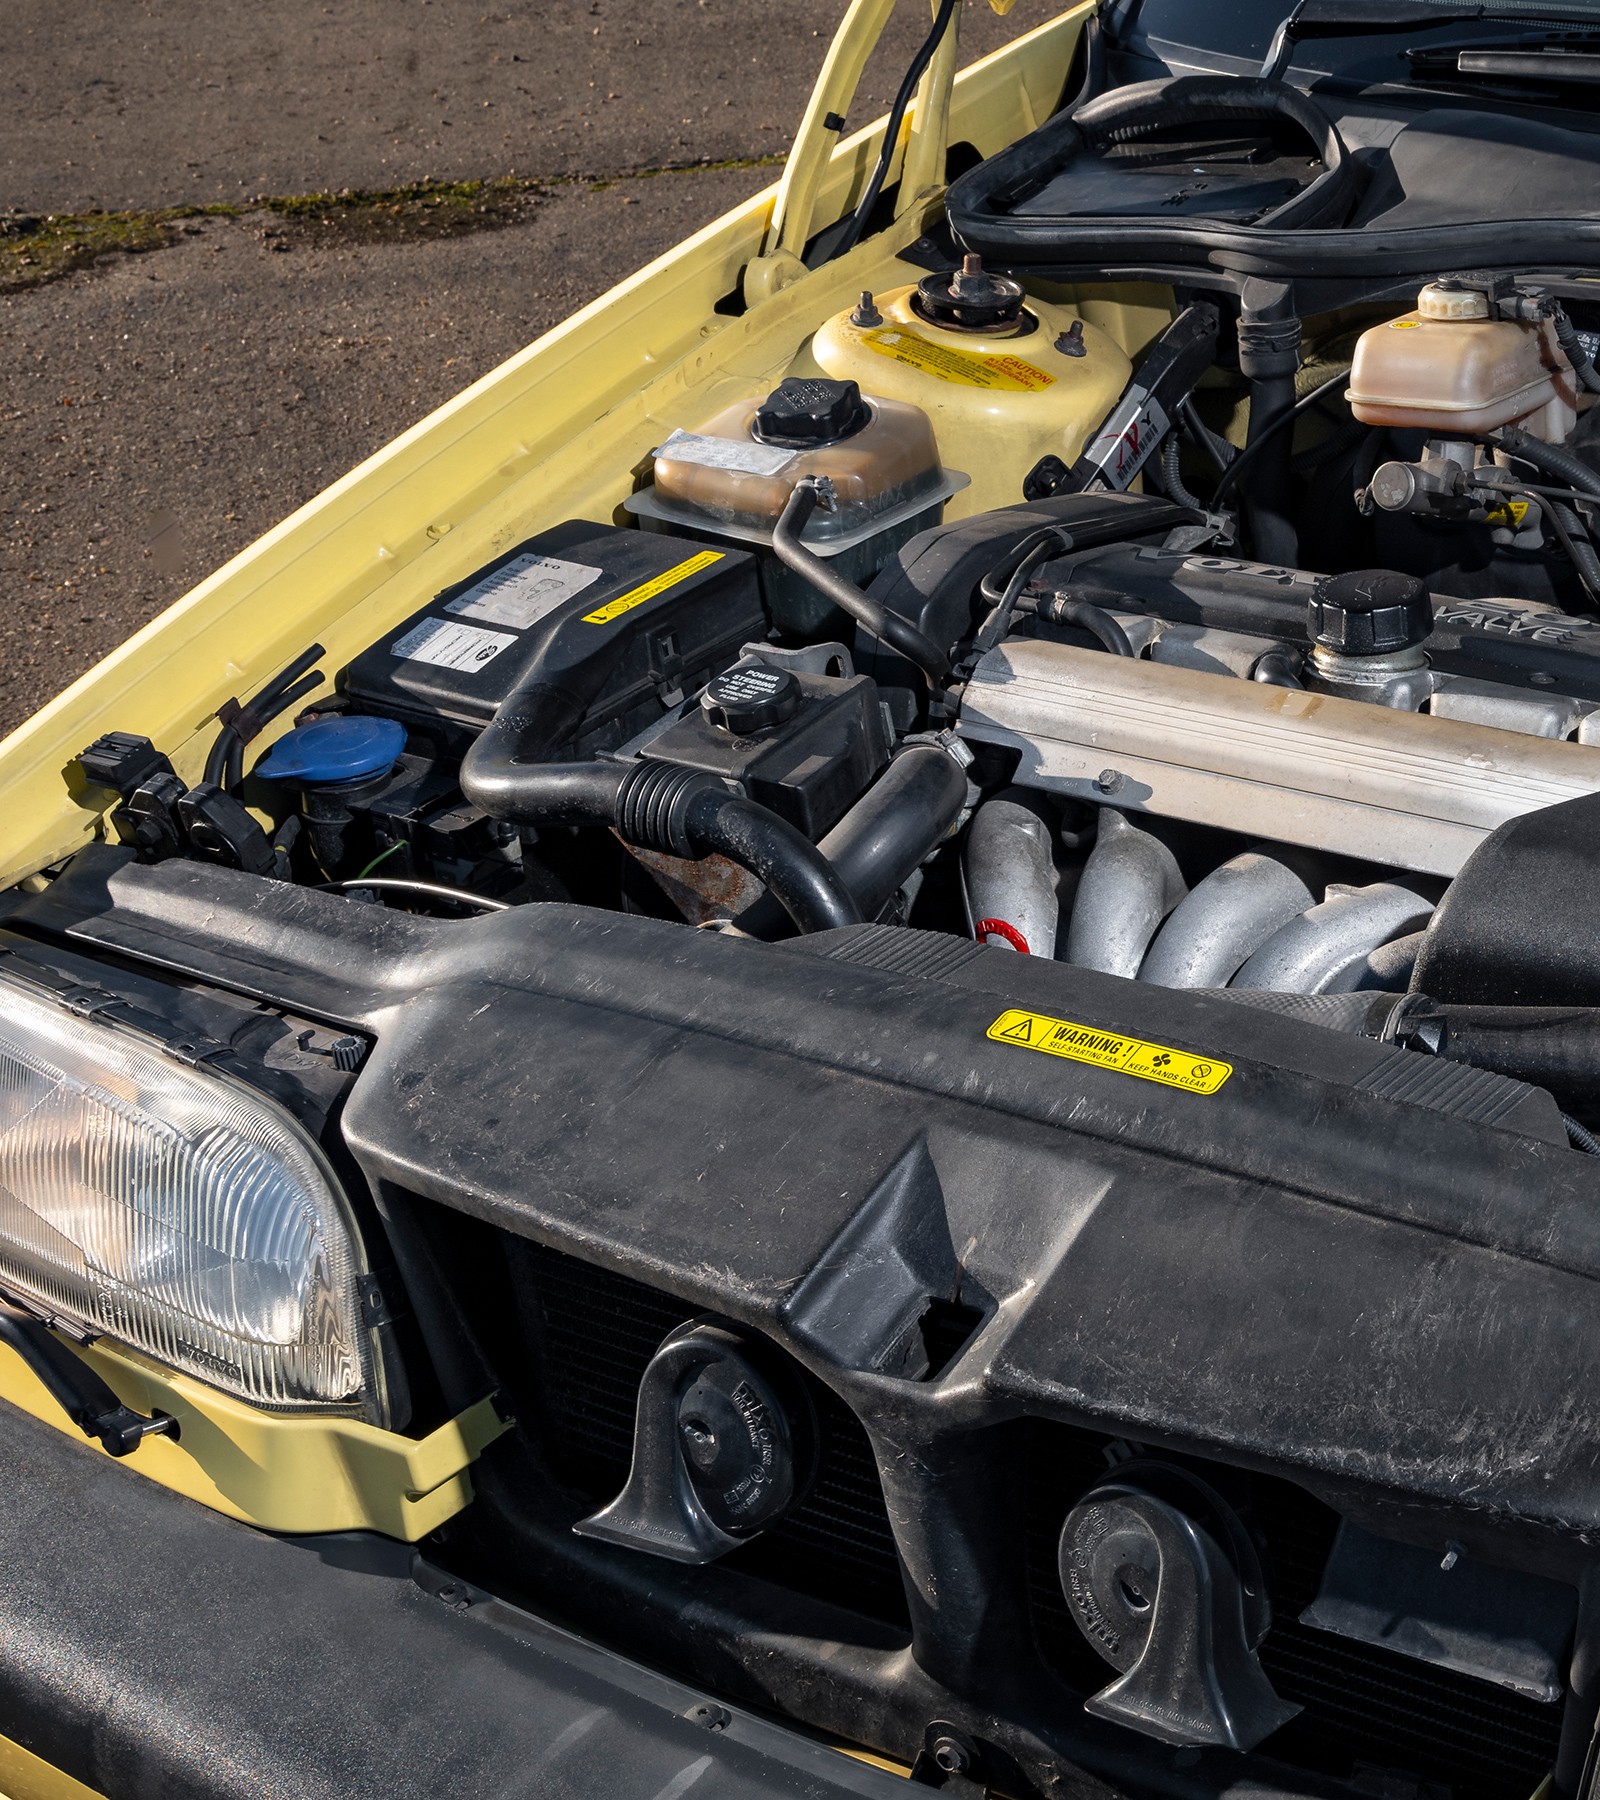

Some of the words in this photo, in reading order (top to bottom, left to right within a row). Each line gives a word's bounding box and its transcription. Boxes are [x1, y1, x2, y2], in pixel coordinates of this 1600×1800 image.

[897, 354, 922, 367] VOLVO
[983, 360, 1035, 388] REFRIGERANT
[1003, 357, 1053, 385] CAUTION!
[520, 557, 561, 571] VOLVO
[1434, 605, 1578, 644] VALVE
[732, 674, 777, 689] STEERING
[745, 669, 780, 682] POWER
[718, 688, 753, 700] APPROVED
[746, 684, 777, 694] OVERFILL
[719, 693, 739, 701] FLUID
[1053, 1026, 1124, 1054] WARNING
[1123, 1045, 1134, 1058] !
[1048, 1041, 1102, 1062] SELF-STARTING
[1103, 1055, 1119, 1064] FAN
[1128, 1062, 1149, 1073] KEEP
[1150, 1067, 1179, 1081] HANDS
[1180, 1074, 1206, 1088] CLEAR
